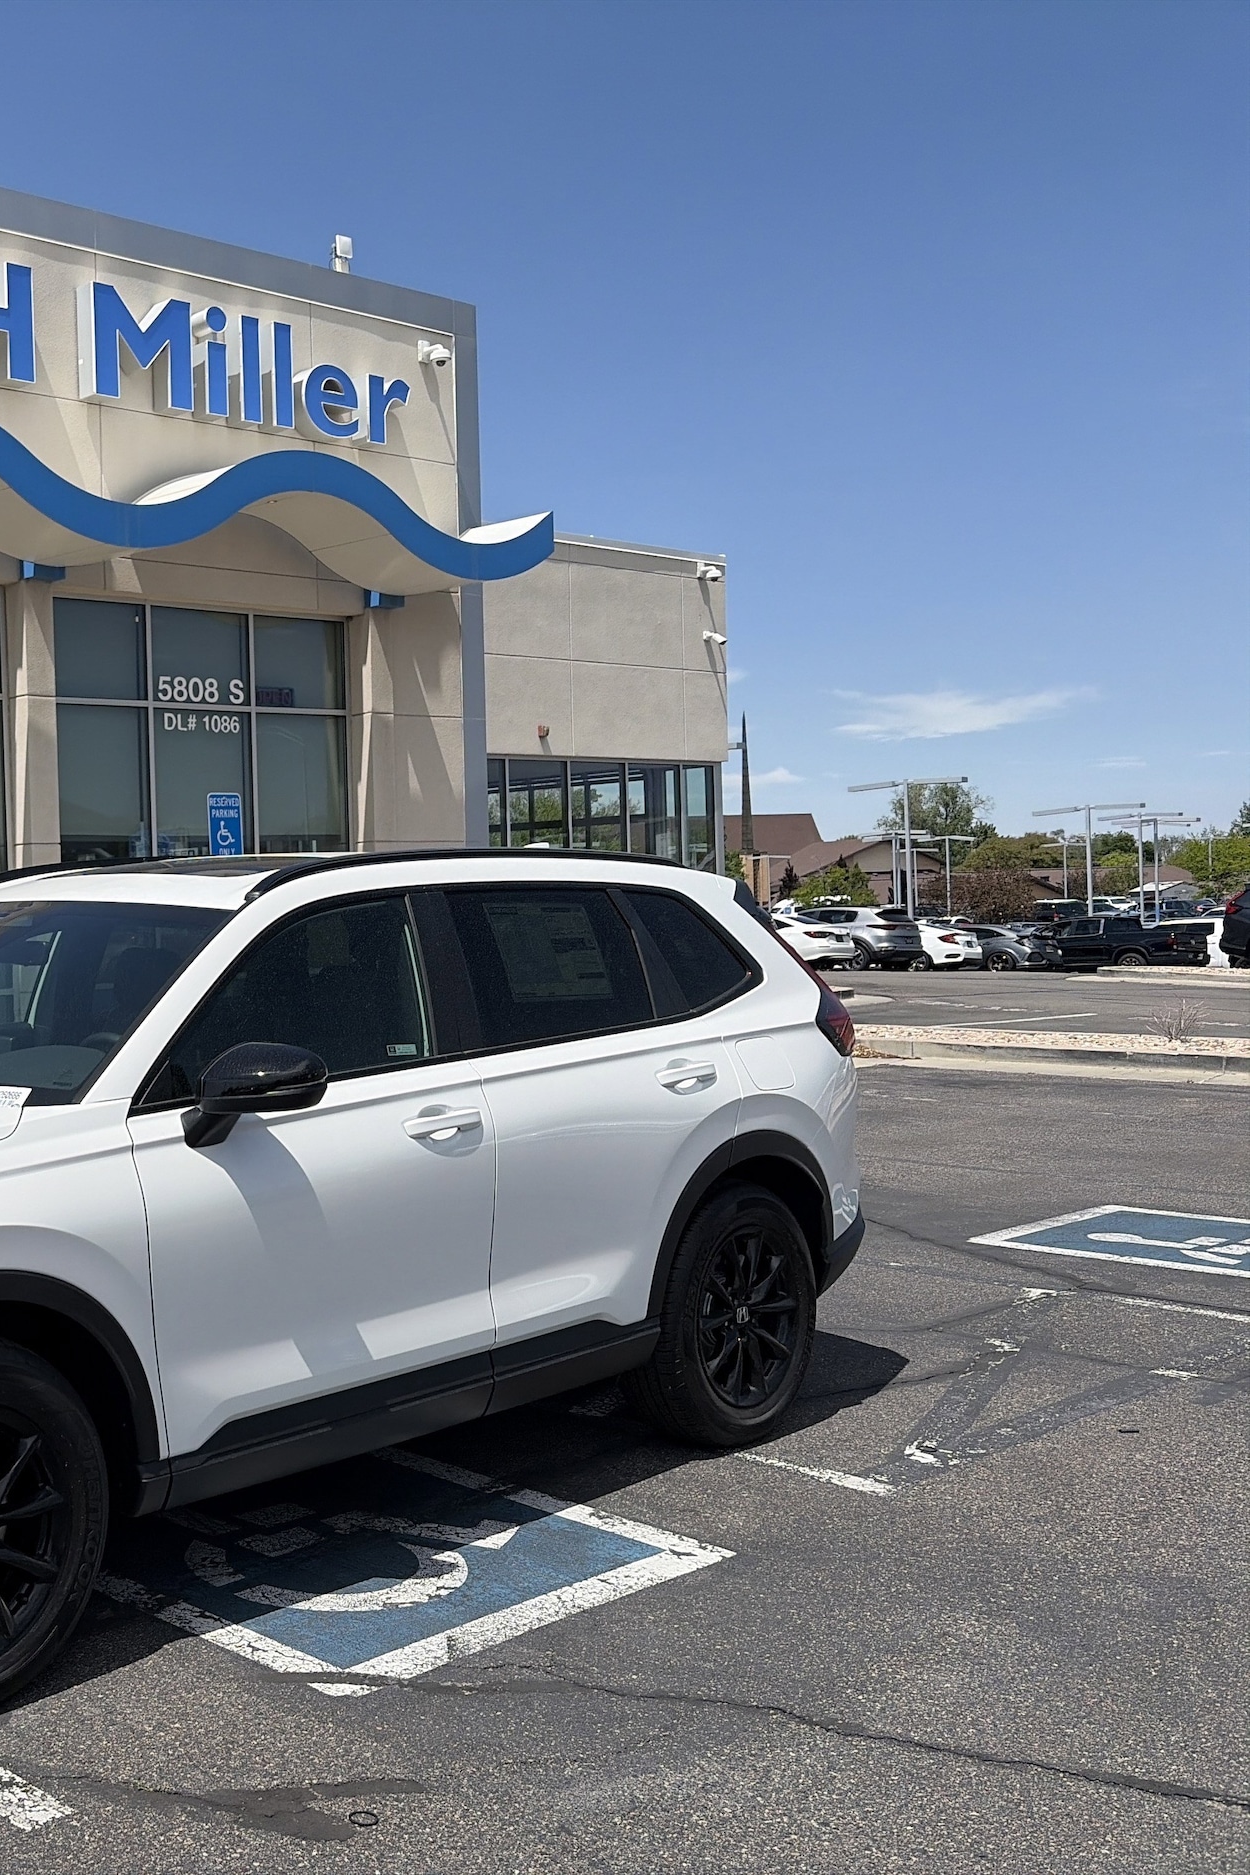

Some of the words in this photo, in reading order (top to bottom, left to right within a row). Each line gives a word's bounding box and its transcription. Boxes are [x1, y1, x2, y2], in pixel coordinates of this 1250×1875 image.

[84, 281, 410, 445] Miller
[157, 675, 219, 703] 5808
[228, 678, 245, 704] S
[163, 712, 197, 731] DL#
[202, 714, 240, 733] 1086
[209, 797, 240, 807] RESERVED
[211, 808, 239, 819] PARKING
